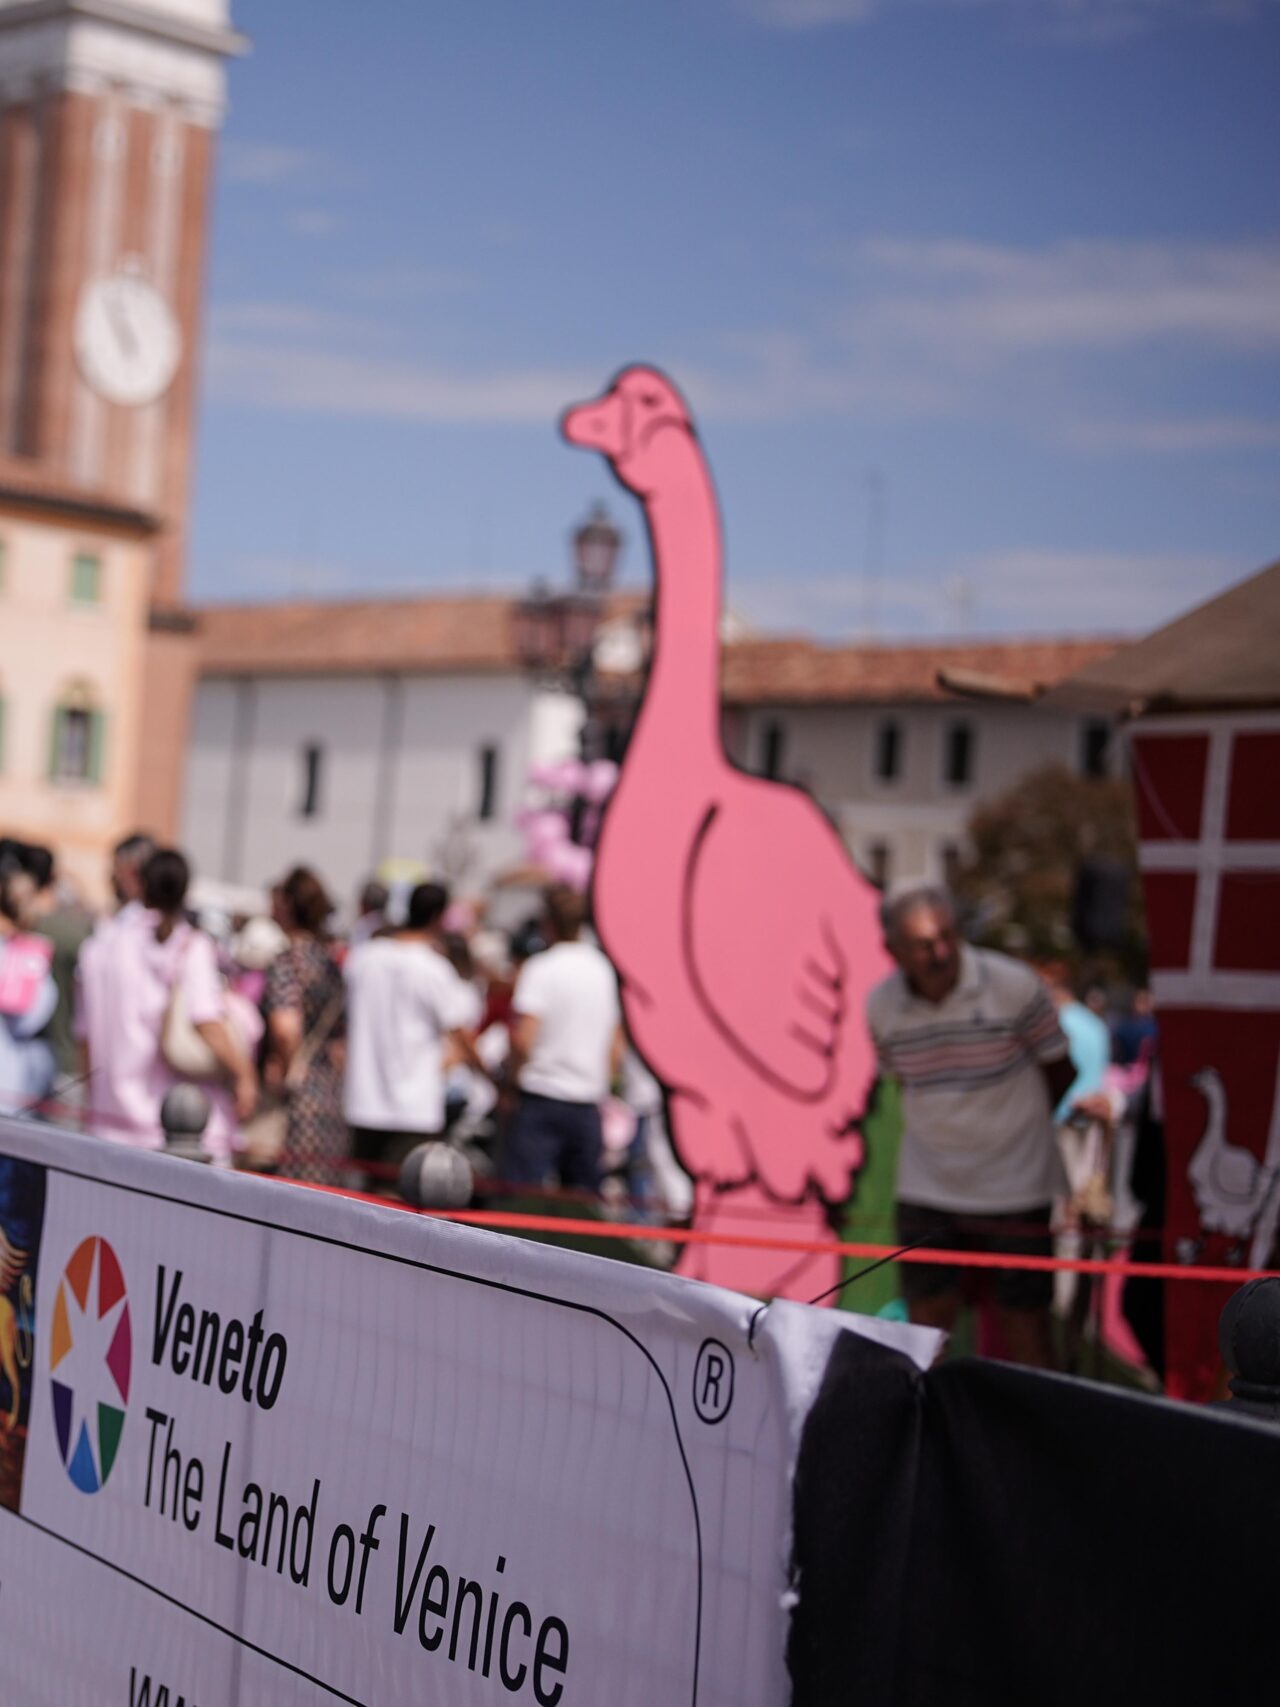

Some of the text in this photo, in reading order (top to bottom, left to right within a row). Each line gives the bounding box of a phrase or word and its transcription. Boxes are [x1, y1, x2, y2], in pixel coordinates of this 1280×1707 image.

[152, 1263, 288, 1410] Veneto
[144, 1406, 570, 1707] The Land of Venice
